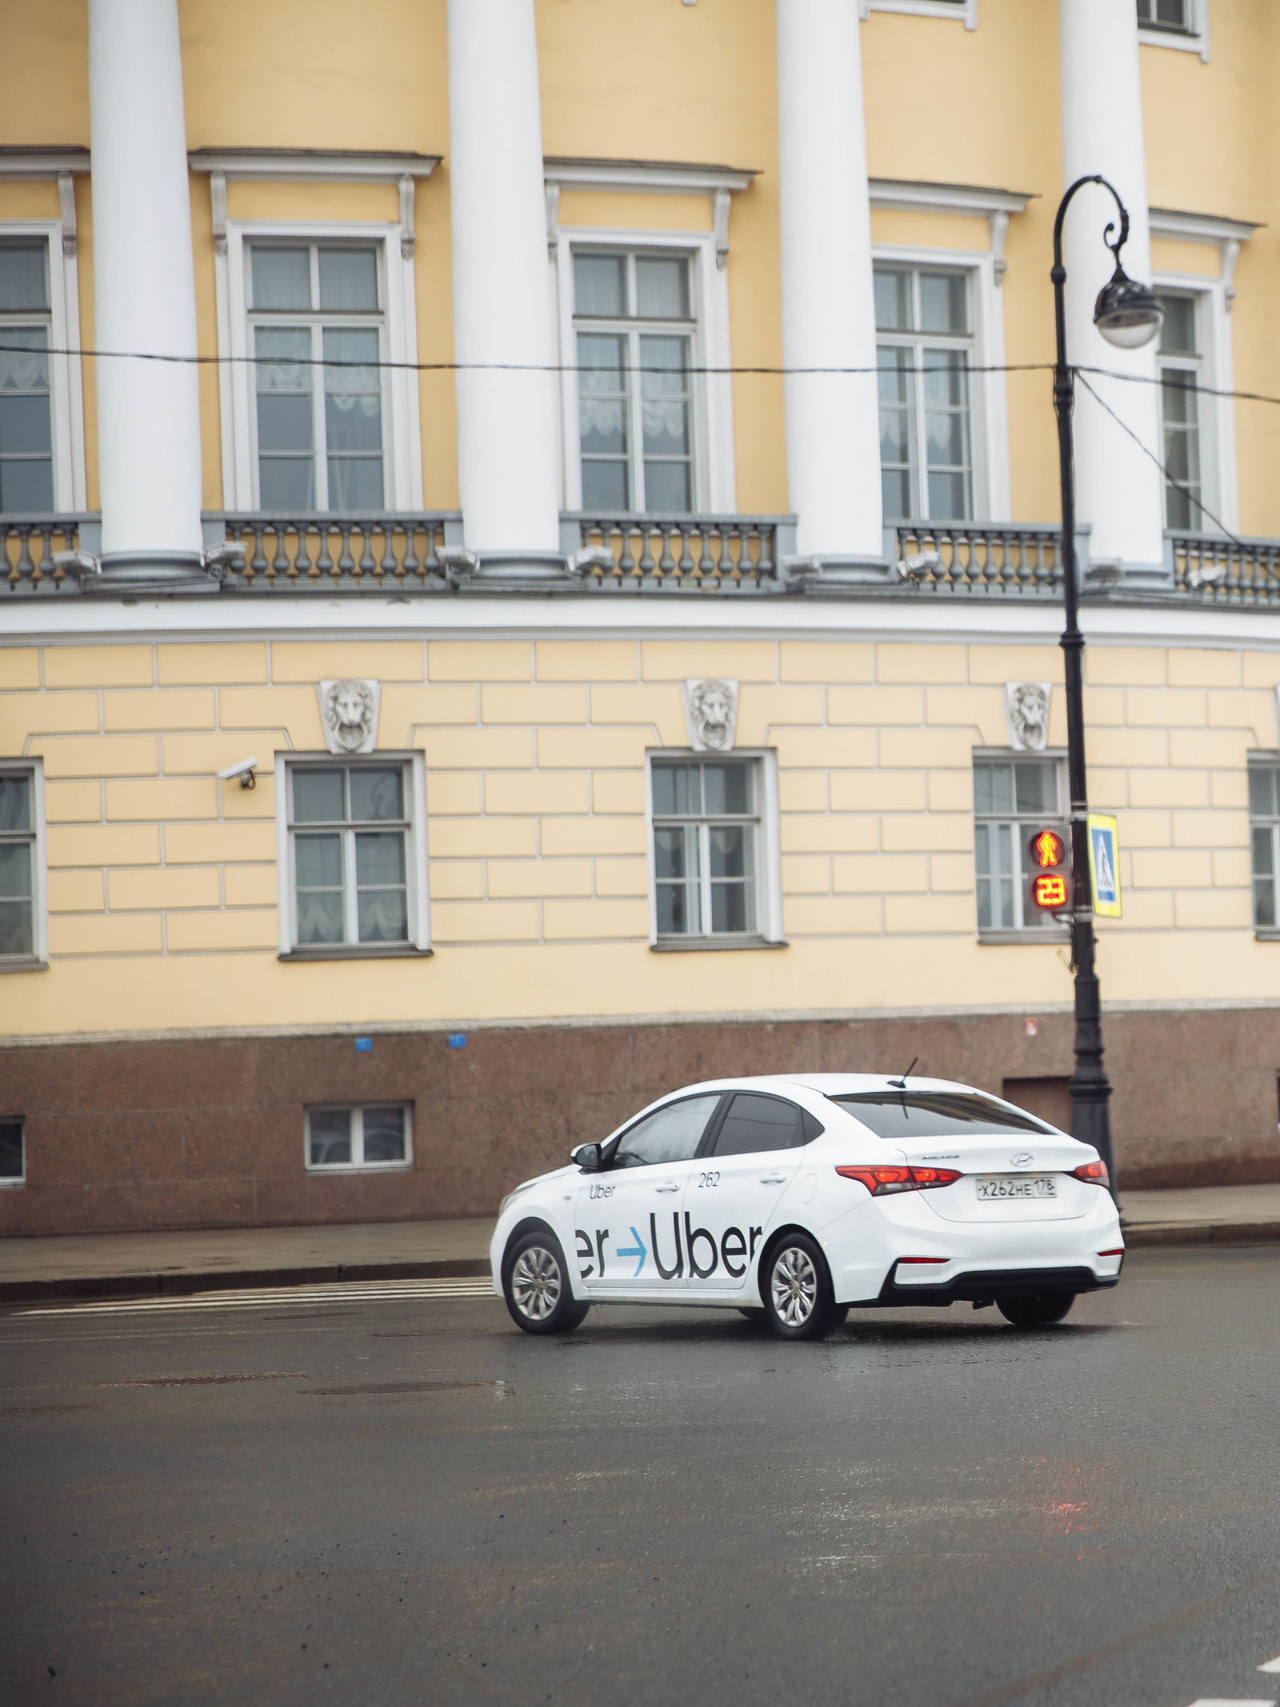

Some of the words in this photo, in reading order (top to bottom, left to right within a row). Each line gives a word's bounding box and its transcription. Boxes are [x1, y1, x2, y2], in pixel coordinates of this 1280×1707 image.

[1036, 875, 1067, 906] 23
[698, 1171, 721, 1188] 262
[589, 1184, 616, 1200] Uber
[650, 1211, 763, 1280] Uber
